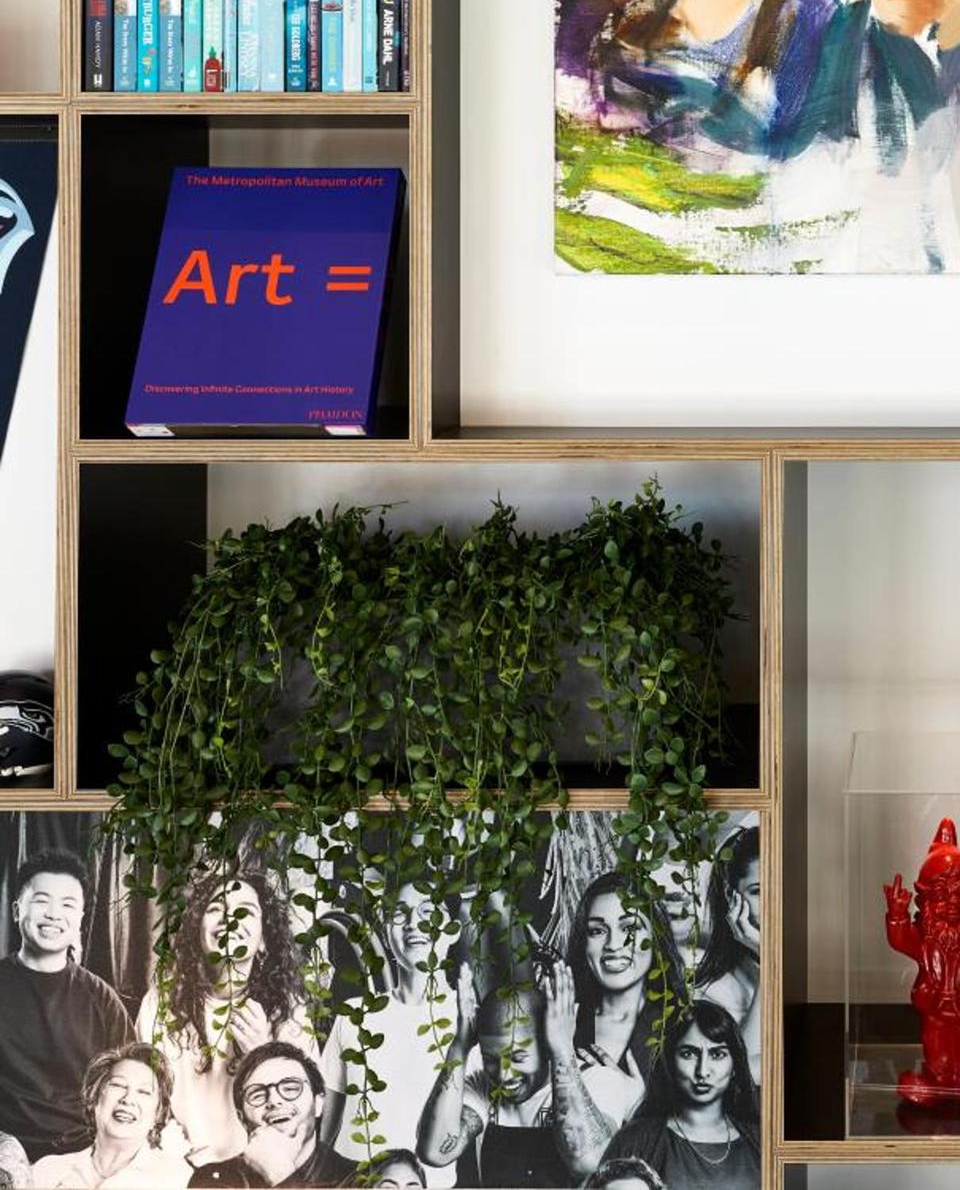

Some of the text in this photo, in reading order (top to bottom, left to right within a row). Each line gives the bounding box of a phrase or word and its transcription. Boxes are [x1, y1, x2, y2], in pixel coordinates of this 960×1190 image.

[383, 10, 394, 37] ARNE
[383, 38, 394, 66] DAHL
[186, 175, 384, 188] The Metropolitan Museum of Art
[162, 249, 296, 306] Art
[144, 383, 200, 396] Discovering
[200, 384, 234, 395] Infinite
[235, 384, 294, 395] Connections
[304, 384, 320, 395] Art
[321, 385, 355, 396] History
